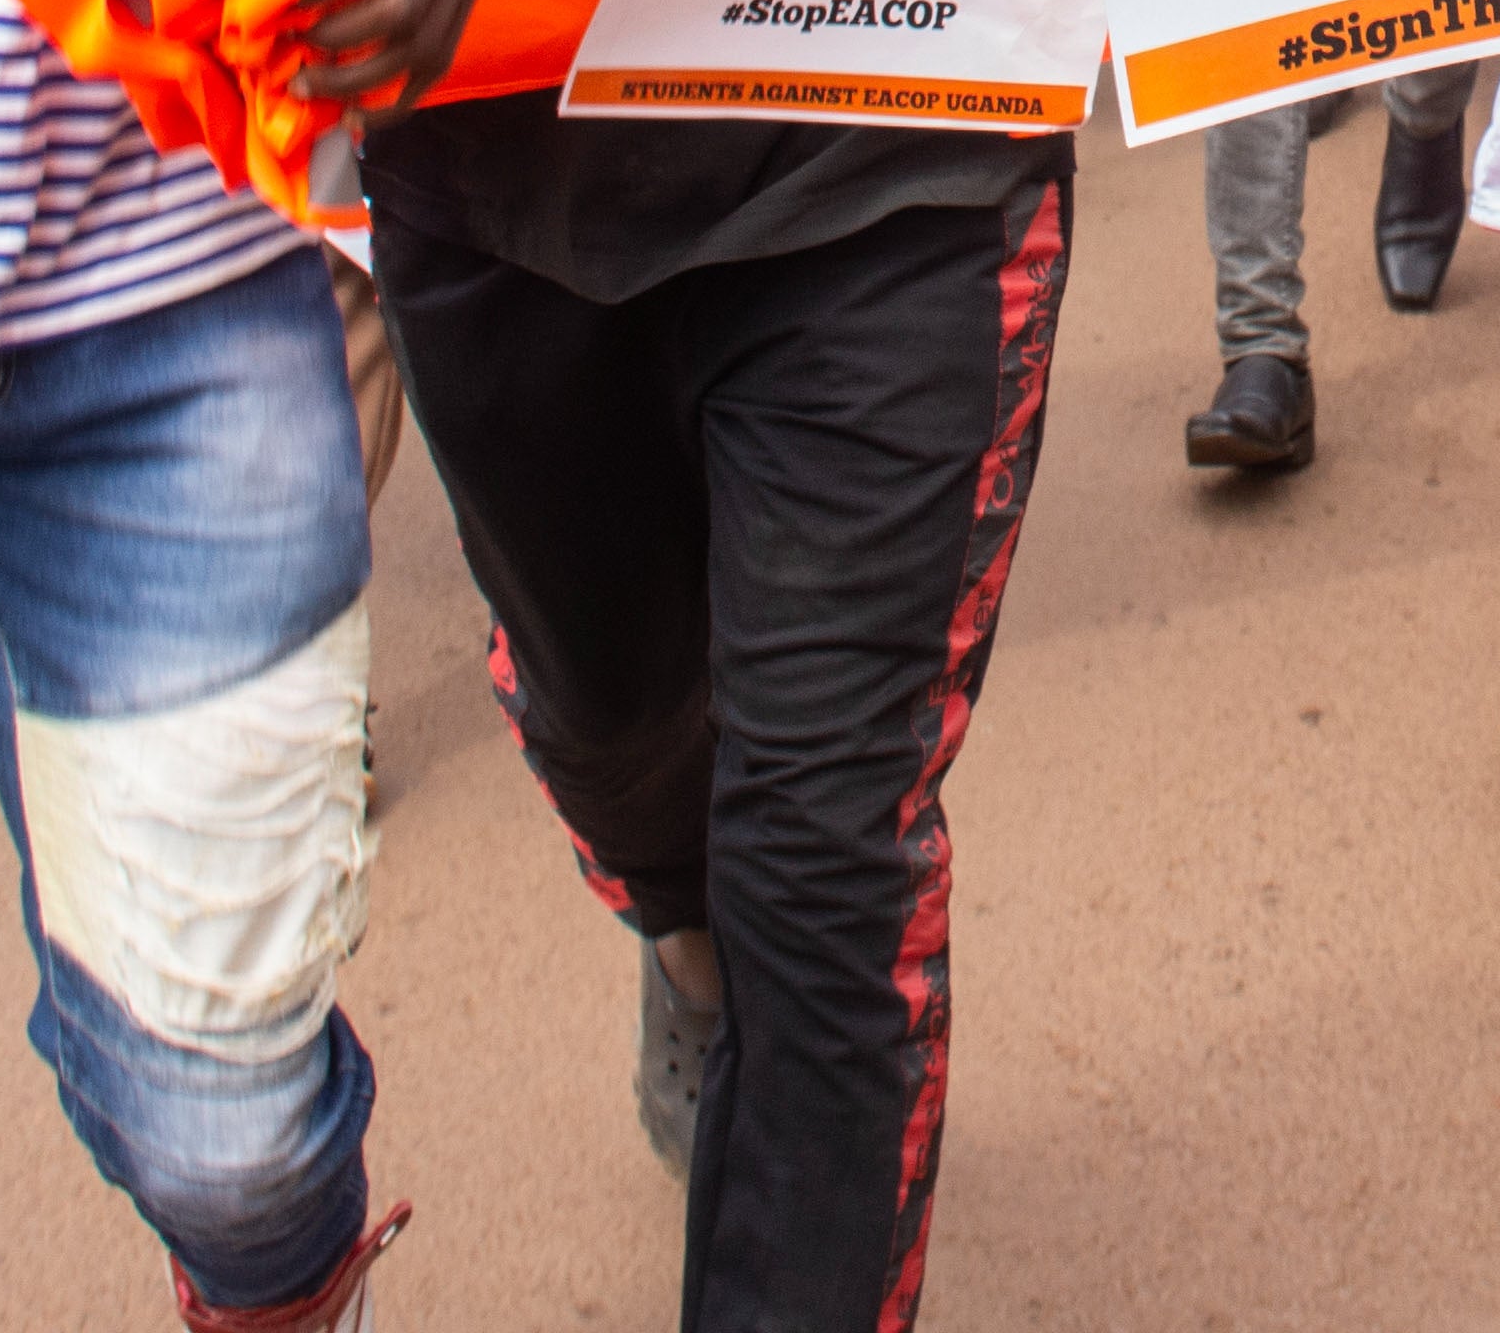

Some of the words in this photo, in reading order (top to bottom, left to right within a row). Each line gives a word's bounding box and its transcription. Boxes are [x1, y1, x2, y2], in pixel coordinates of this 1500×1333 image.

[620, 79, 745, 102] STUDENTS
[749, 84, 858, 107] AGAINST
[863, 89, 941, 111] EACOP
[946, 93, 1044, 117] UGANDA
